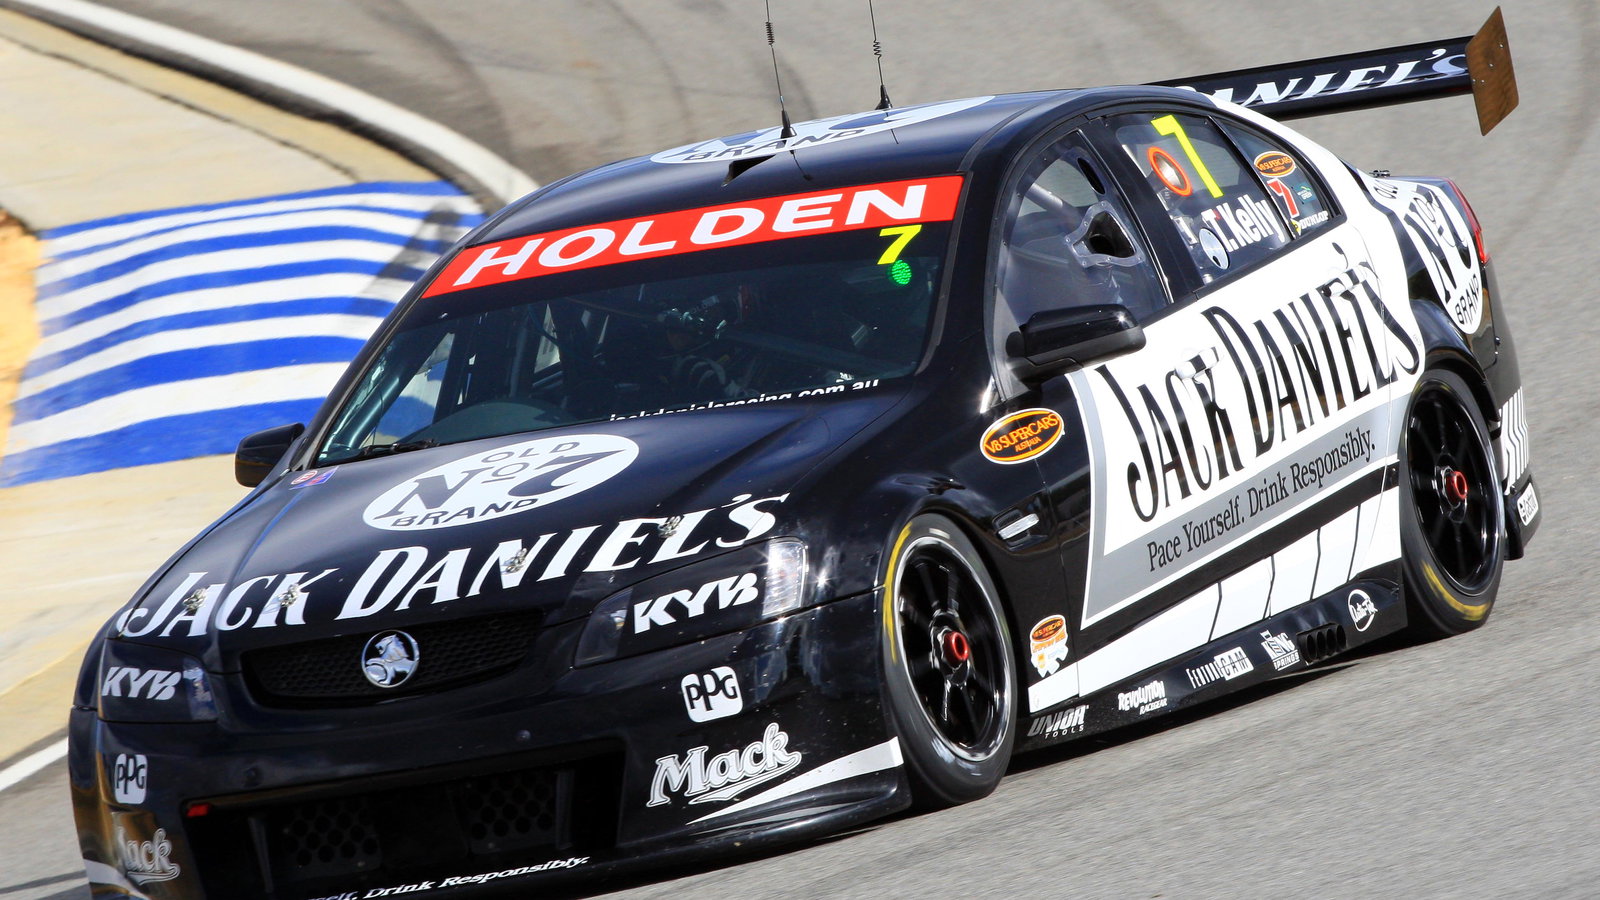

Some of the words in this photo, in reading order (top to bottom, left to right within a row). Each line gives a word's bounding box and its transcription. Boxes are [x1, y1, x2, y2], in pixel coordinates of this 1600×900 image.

[1151, 114, 1224, 199] 7
[1267, 178, 1300, 219] 7
[452, 184, 929, 287] HOLDEN
[1201, 194, 1287, 253] T.Kelly
[1299, 210, 1330, 230] DUNLOP
[877, 224, 923, 266] 7
[1455, 273, 1480, 325] BRAND
[1094, 345, 1245, 523] JACK
[1200, 241, 1421, 458] DANIEL'S
[999, 413, 1060, 448] SUPERCARS
[1015, 436, 1042, 453] AUSTRALIA
[481, 441, 581, 463] OLD
[391, 498, 538, 527] BRAND
[1147, 534, 1183, 573] Pace
[1182, 496, 1246, 554] Yourself.
[1248, 468, 1290, 519] Drink
[1291, 427, 1376, 494] Responsibly.
[115, 567, 339, 638] JACK
[333, 492, 790, 622] DANIEL'S
[634, 572, 759, 634] KYB
[102, 666, 182, 700] KYB
[684, 668, 739, 712] PPG
[1117, 680, 1166, 711] REVOLUTION
[1027, 705, 1087, 737] UNIOR
[1139, 698, 1168, 715] RACEGEAR
[1044, 725, 1085, 740] TOOLS
[115, 754, 147, 796] PPG
[646, 722, 802, 808] Mack
[363, 880, 436, 900] Drink
[438, 855, 590, 889] Responsibly.
